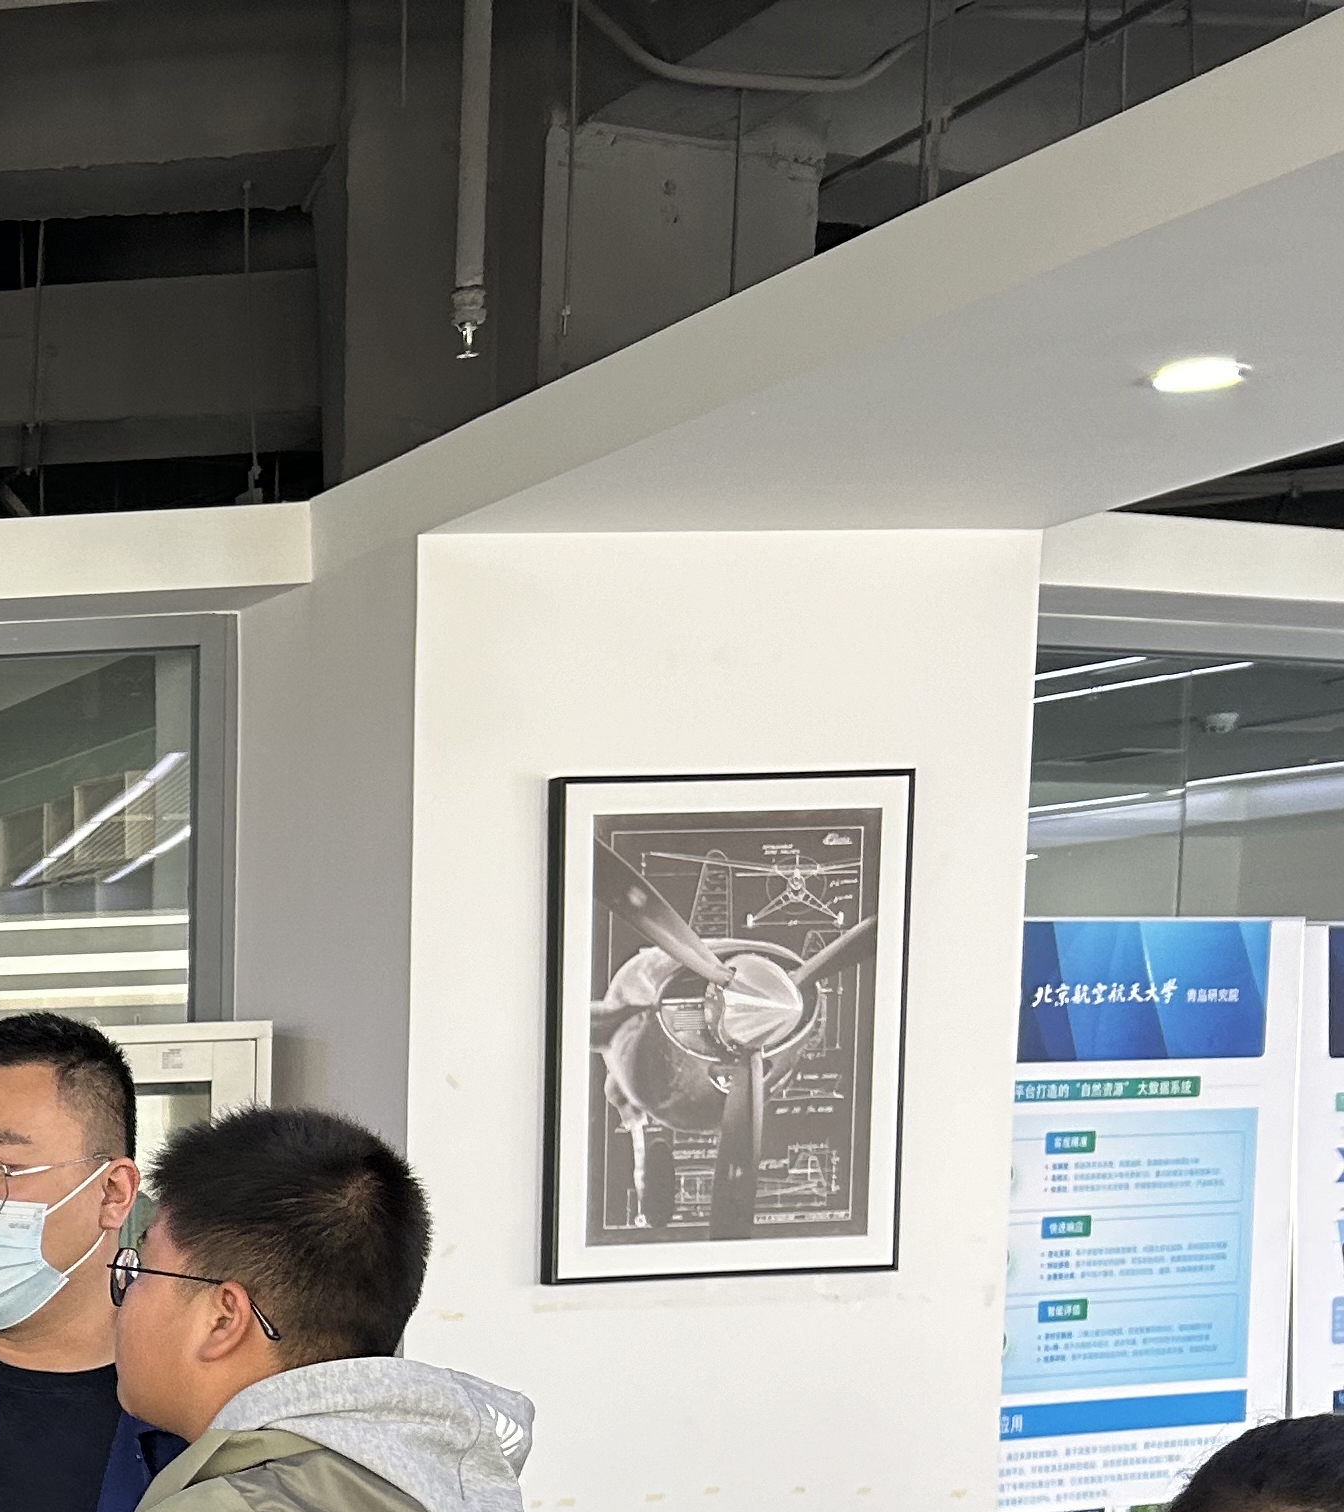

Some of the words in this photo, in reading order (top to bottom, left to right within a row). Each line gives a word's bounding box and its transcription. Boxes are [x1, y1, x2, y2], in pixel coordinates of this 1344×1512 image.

[1032, 978, 1178, 1007] 北京航空航天大学
[1186, 988, 1240, 1003] 青岛研究院
